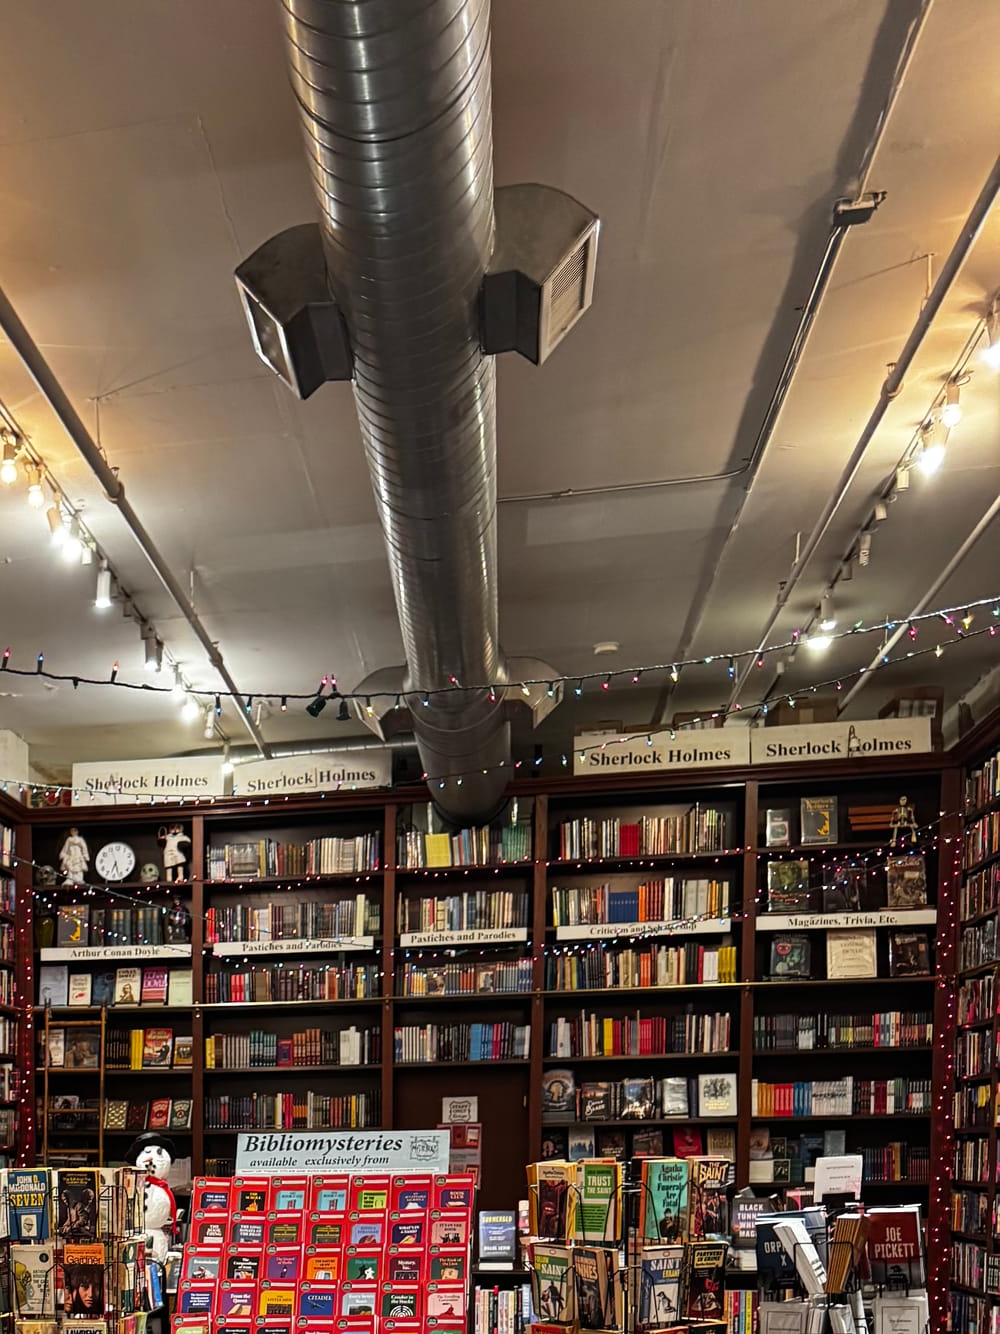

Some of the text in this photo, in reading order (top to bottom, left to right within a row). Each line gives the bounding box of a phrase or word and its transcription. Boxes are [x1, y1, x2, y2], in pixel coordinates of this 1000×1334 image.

[767, 739, 911, 757] Sherlock olmes
[589, 748, 730, 767] Sherlock Holmes
[86, 774, 208, 790] Sherlock Holmes
[248, 769, 375, 793] Sherlock Holmes
[788, 914, 897, 927] Magazines, Trivia, Etc.
[411, 931, 516, 943] Pastiches and Parodies
[71, 950, 100, 958] Arthur
[104, 949, 132, 957] Conan
[242, 942, 285, 952] Pastiches
[288, 942, 303, 951] and
[243, 1134, 403, 1155] Bibliomysteries
[250, 1155, 388, 1167] available exclusively from
[587, 1176, 611, 1186] TRUST
[700, 1164, 728, 1184] SAINT
[10, 1193, 45, 1206] SEVEN
[885, 1227, 902, 1242] JOE
[874, 1243, 915, 1259] PICKETT
